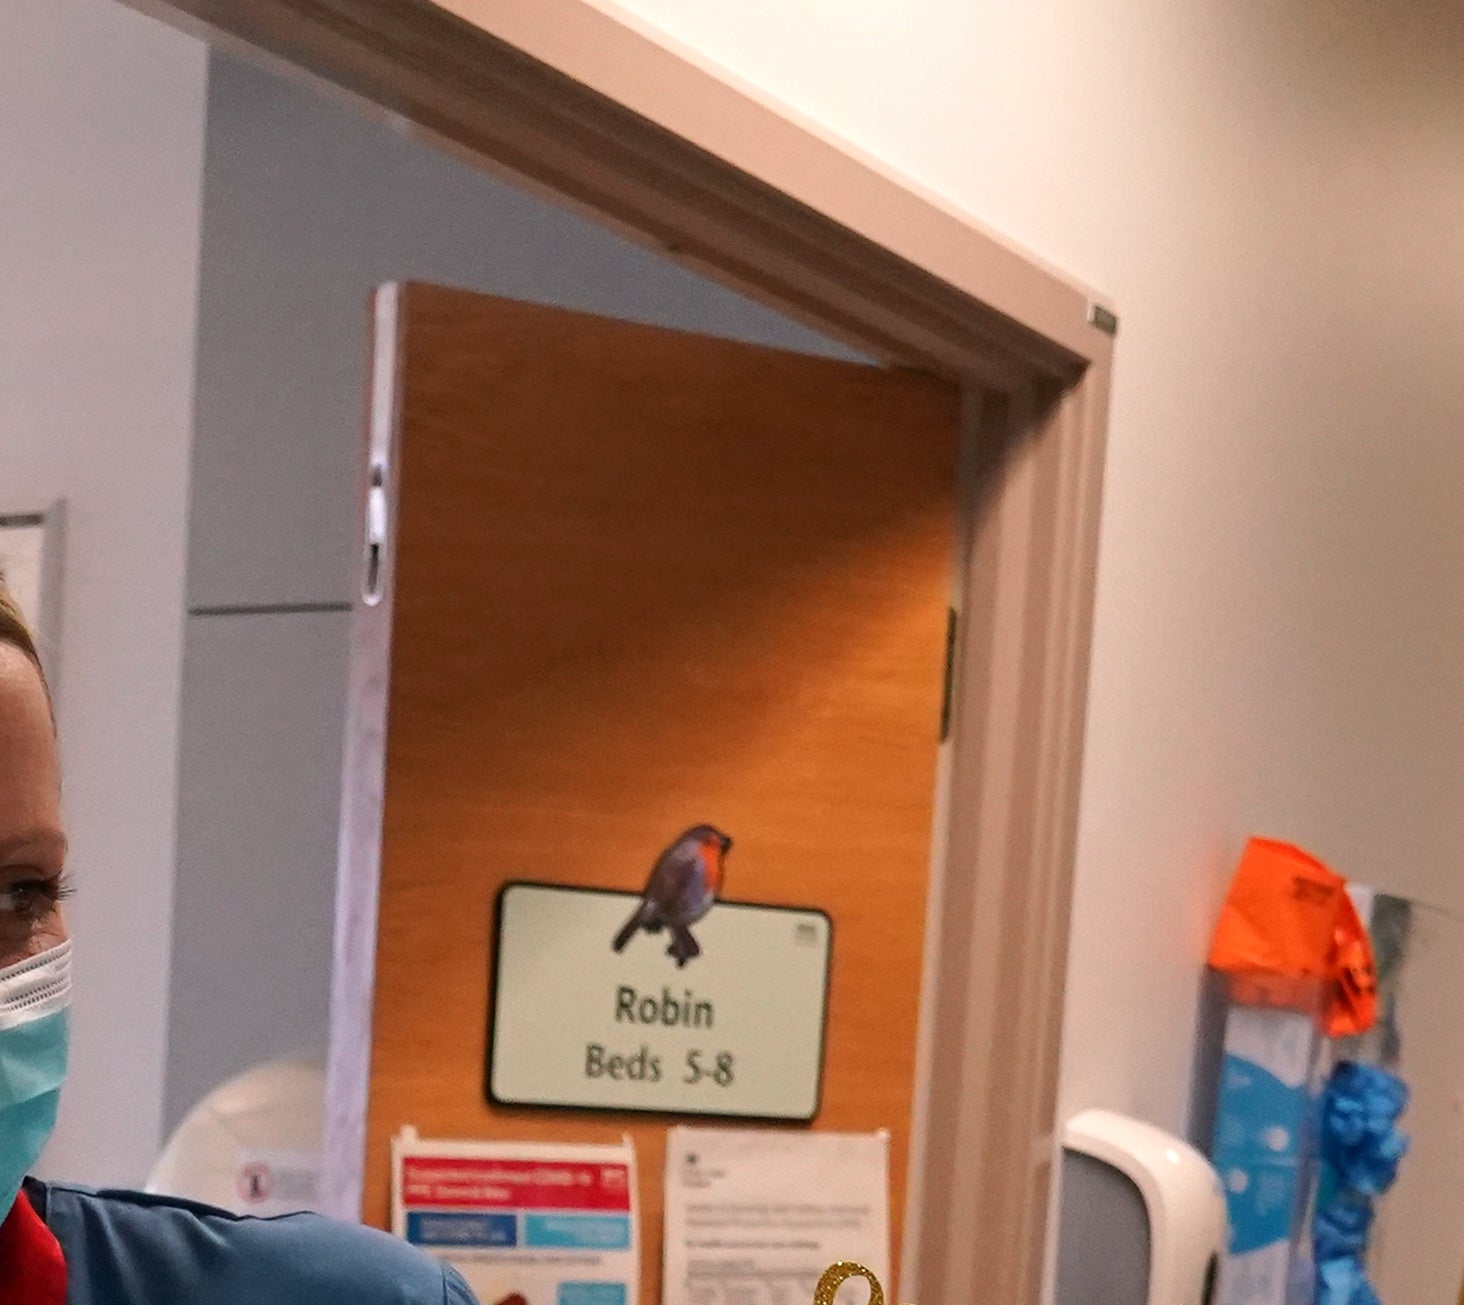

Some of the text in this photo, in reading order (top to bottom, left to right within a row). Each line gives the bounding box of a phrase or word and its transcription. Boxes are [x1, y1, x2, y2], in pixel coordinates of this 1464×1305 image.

[613, 983, 716, 1030] Robin
[583, 1042, 736, 1088] Beds 5-8
